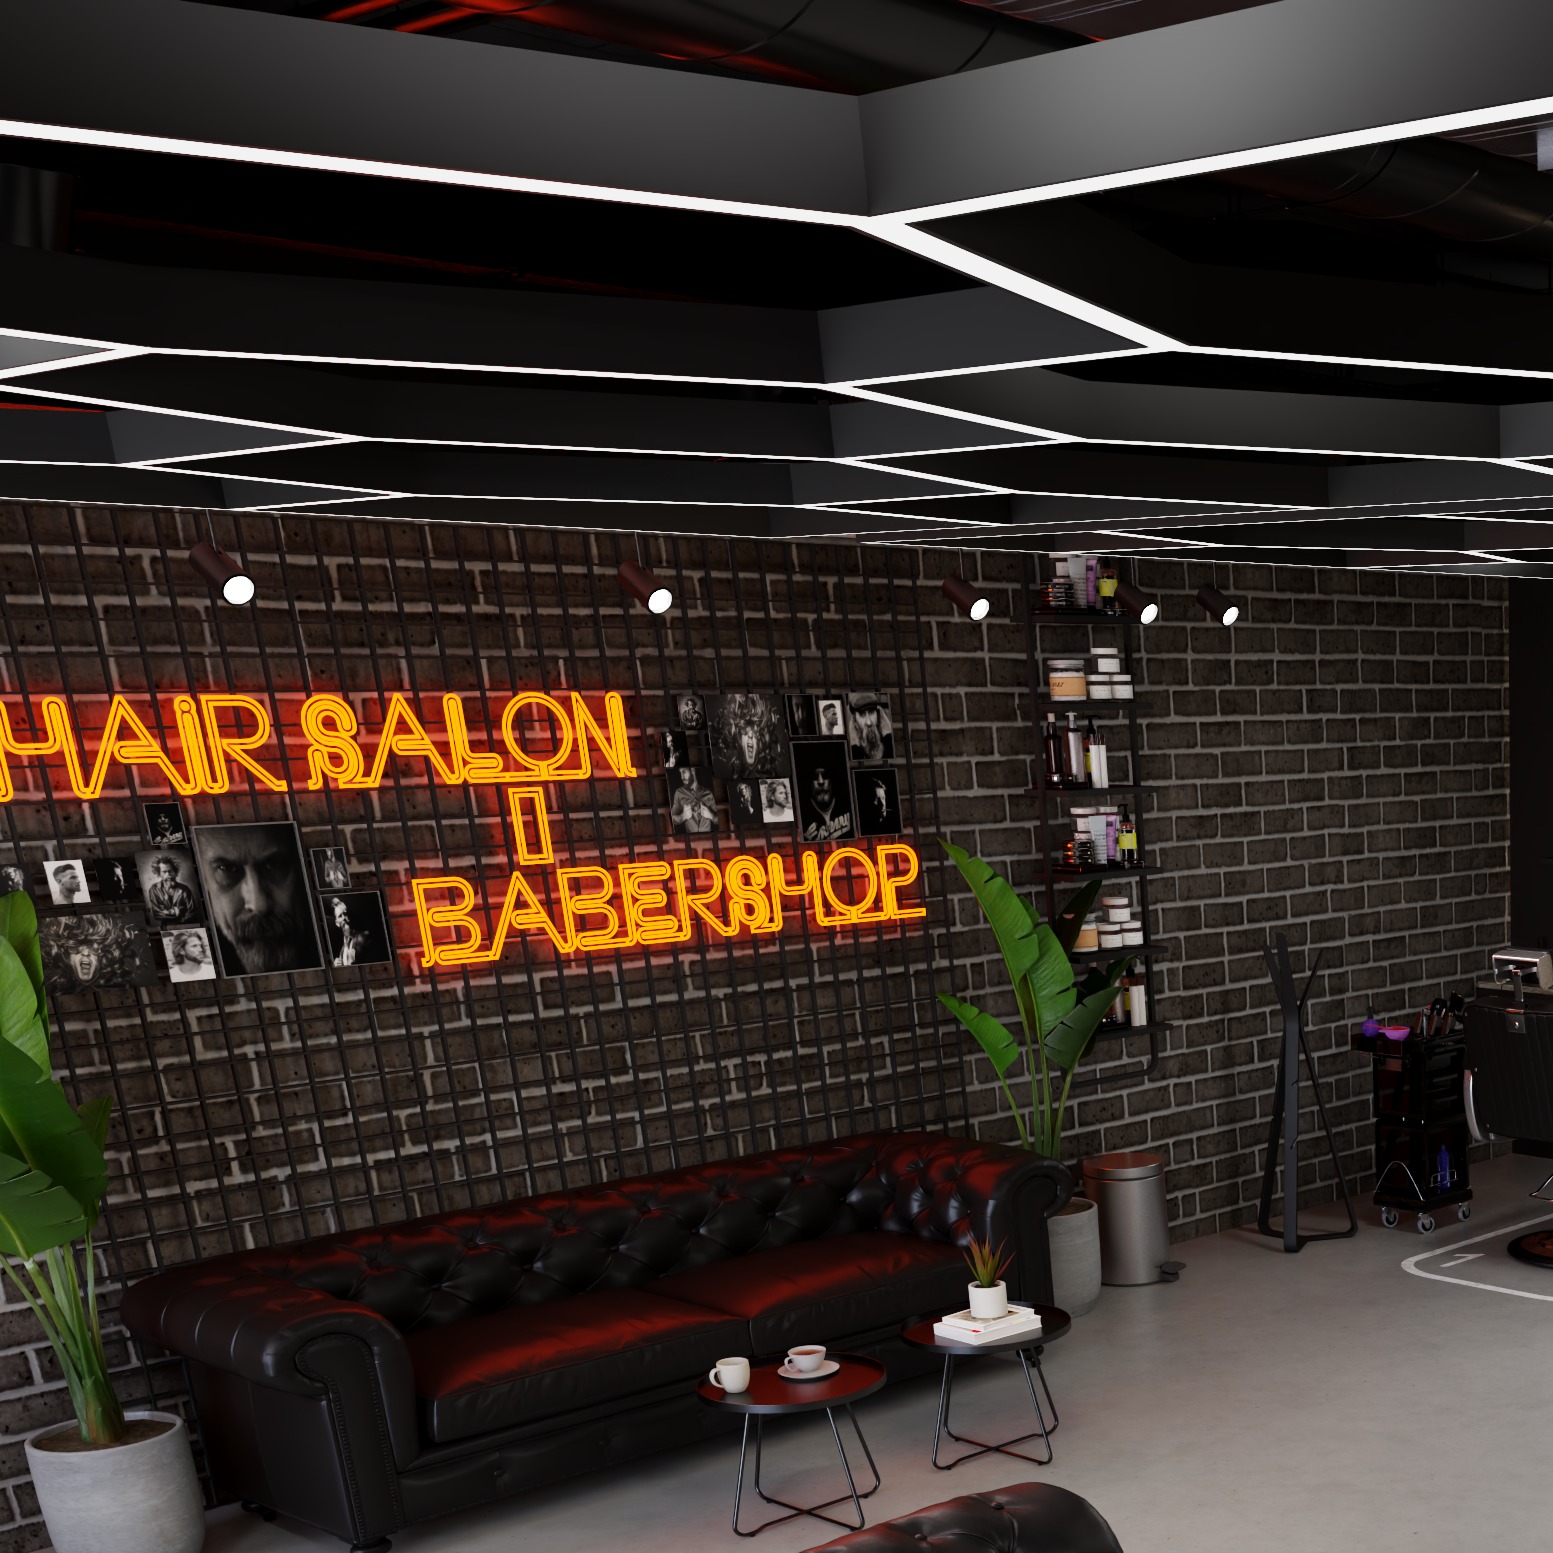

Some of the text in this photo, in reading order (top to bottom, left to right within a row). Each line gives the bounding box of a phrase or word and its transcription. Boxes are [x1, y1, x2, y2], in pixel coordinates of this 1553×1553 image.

[301, 691, 638, 790] SALON
[412, 843, 926, 967] BABERSHOP
[1440, 1253, 1485, 1268] 1
